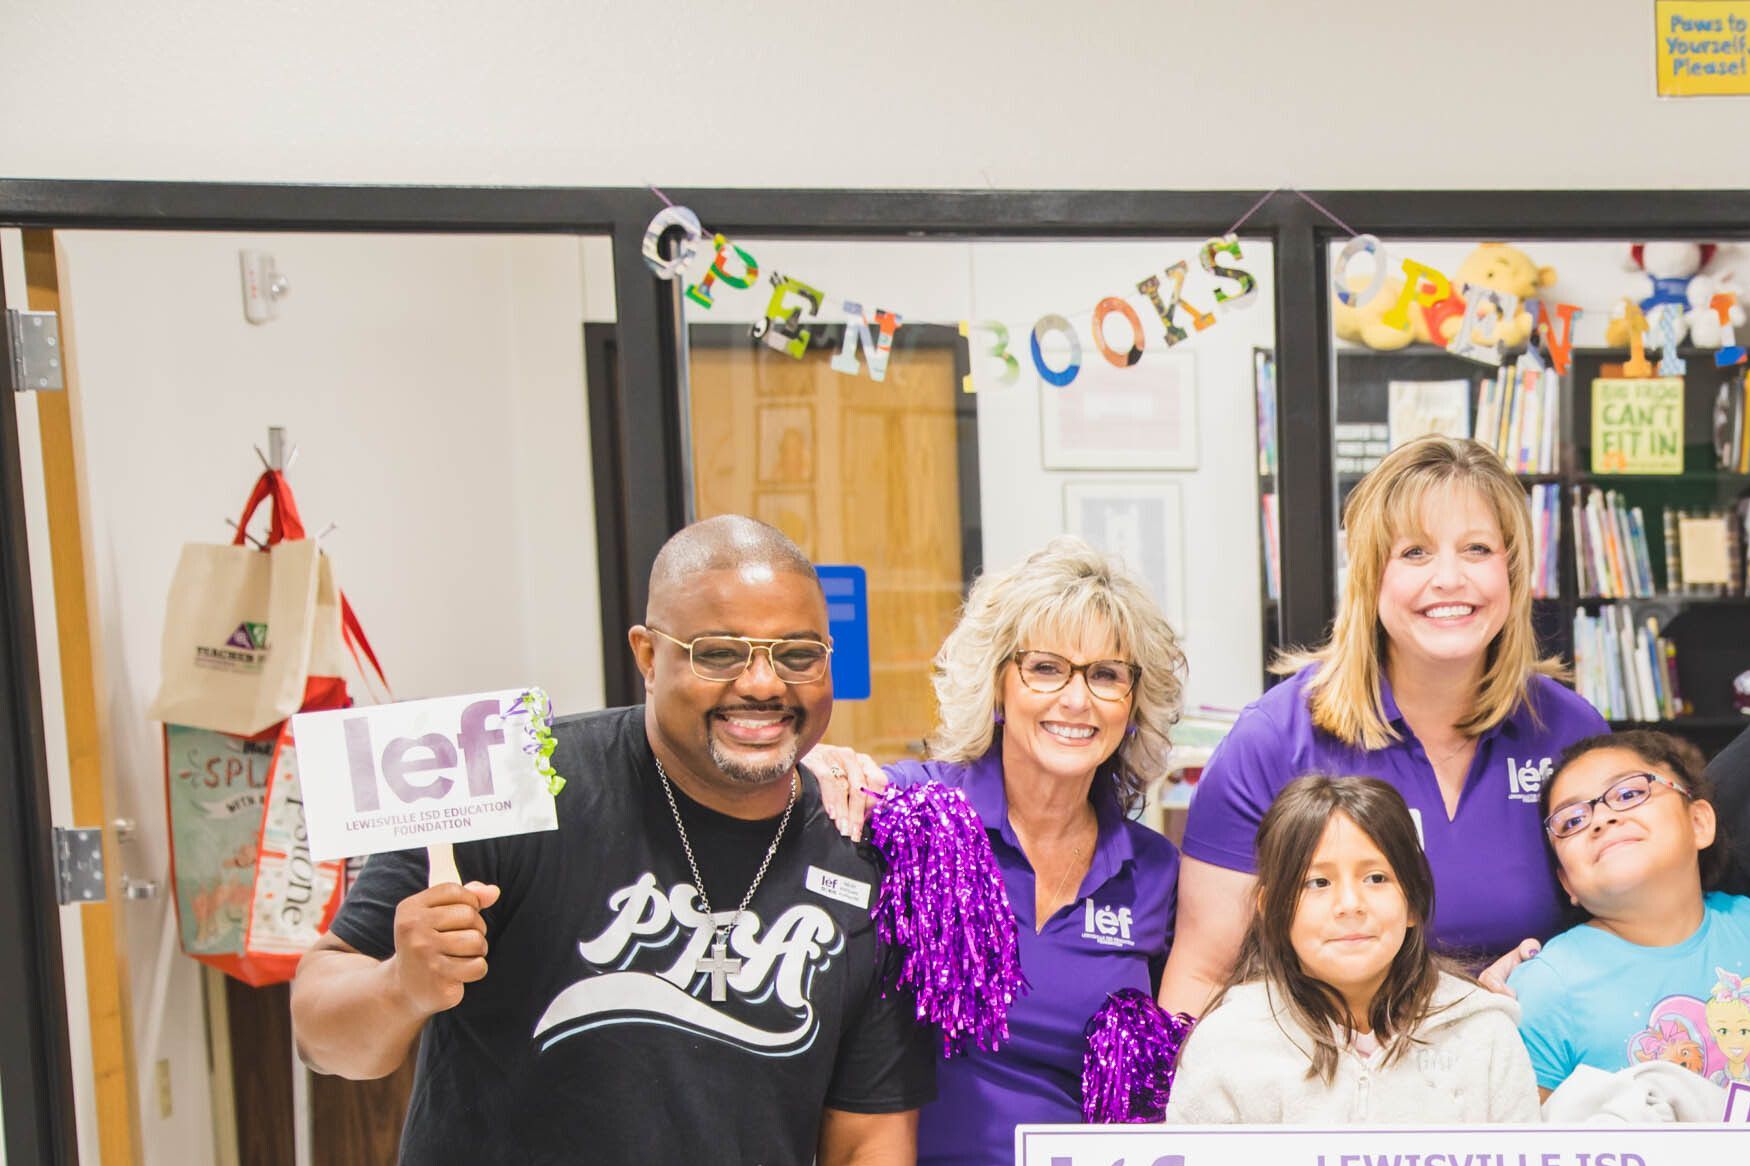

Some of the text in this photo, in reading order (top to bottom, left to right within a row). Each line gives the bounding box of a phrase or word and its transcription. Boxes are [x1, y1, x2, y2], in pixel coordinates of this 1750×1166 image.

[1671, 13, 1748, 33] Paws to
[1673, 57, 1748, 77] Please!
[642, 206, 1259, 393] OPEN BOOKS
[1649, 431, 1678, 456] IN
[345, 800, 513, 832] LEWISVILLE ISD EDUCATION
[393, 817, 473, 838] FOUNDATION
